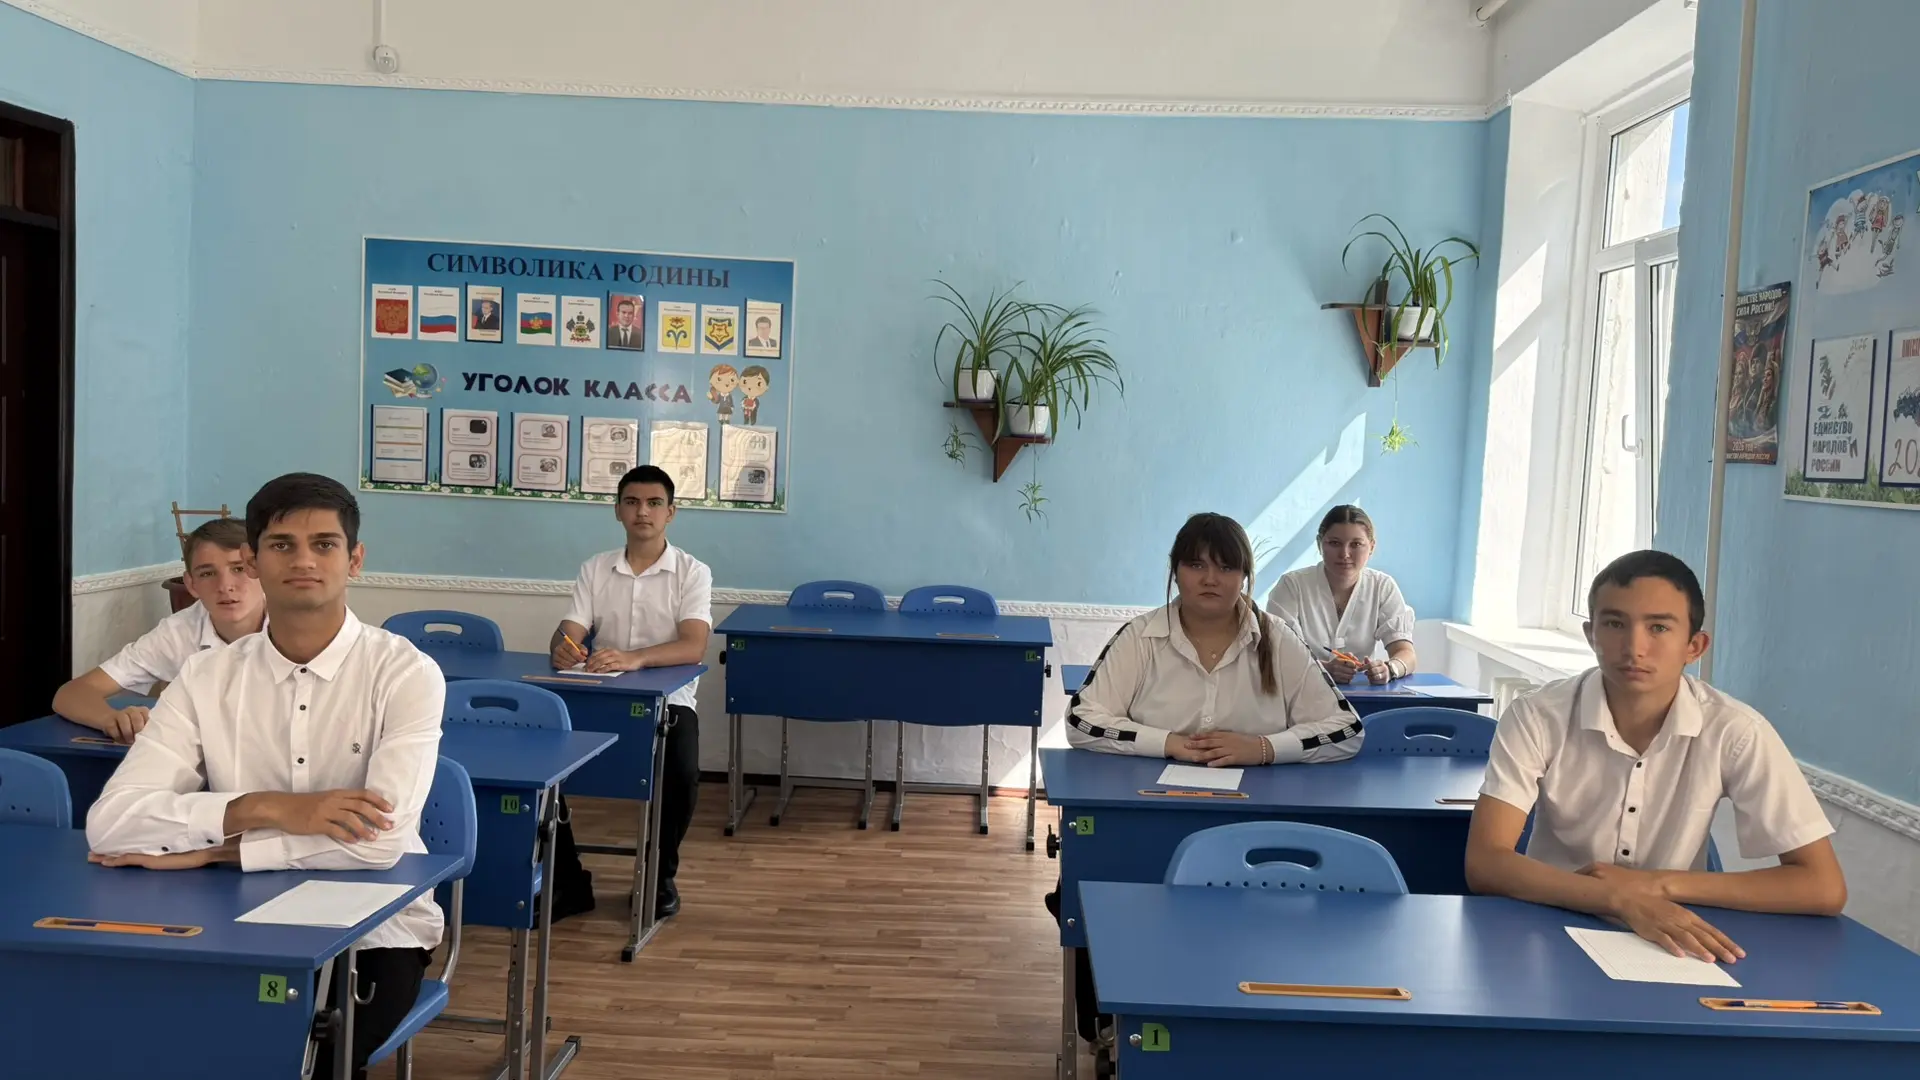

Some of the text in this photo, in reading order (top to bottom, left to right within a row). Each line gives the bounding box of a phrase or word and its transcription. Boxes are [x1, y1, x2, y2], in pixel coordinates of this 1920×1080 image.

[427, 253, 730, 288] СИМВОЛИКА РОДИНЫ
[462, 372, 692, 403] УГОЛОК КЛАССА
[1813, 421, 1853, 436] ЕДИНСТВО
[1812, 439, 1848, 455] НАРОДОВ
[1811, 459, 1841, 472] РОССИИ
[1888, 438, 1920, 477] 20
[632, 705, 643, 715] 12
[504, 799, 518, 811] 10
[1080, 819, 1089, 832] 3
[267, 980, 278, 998] 8
[1151, 1028, 1160, 1047] 1
